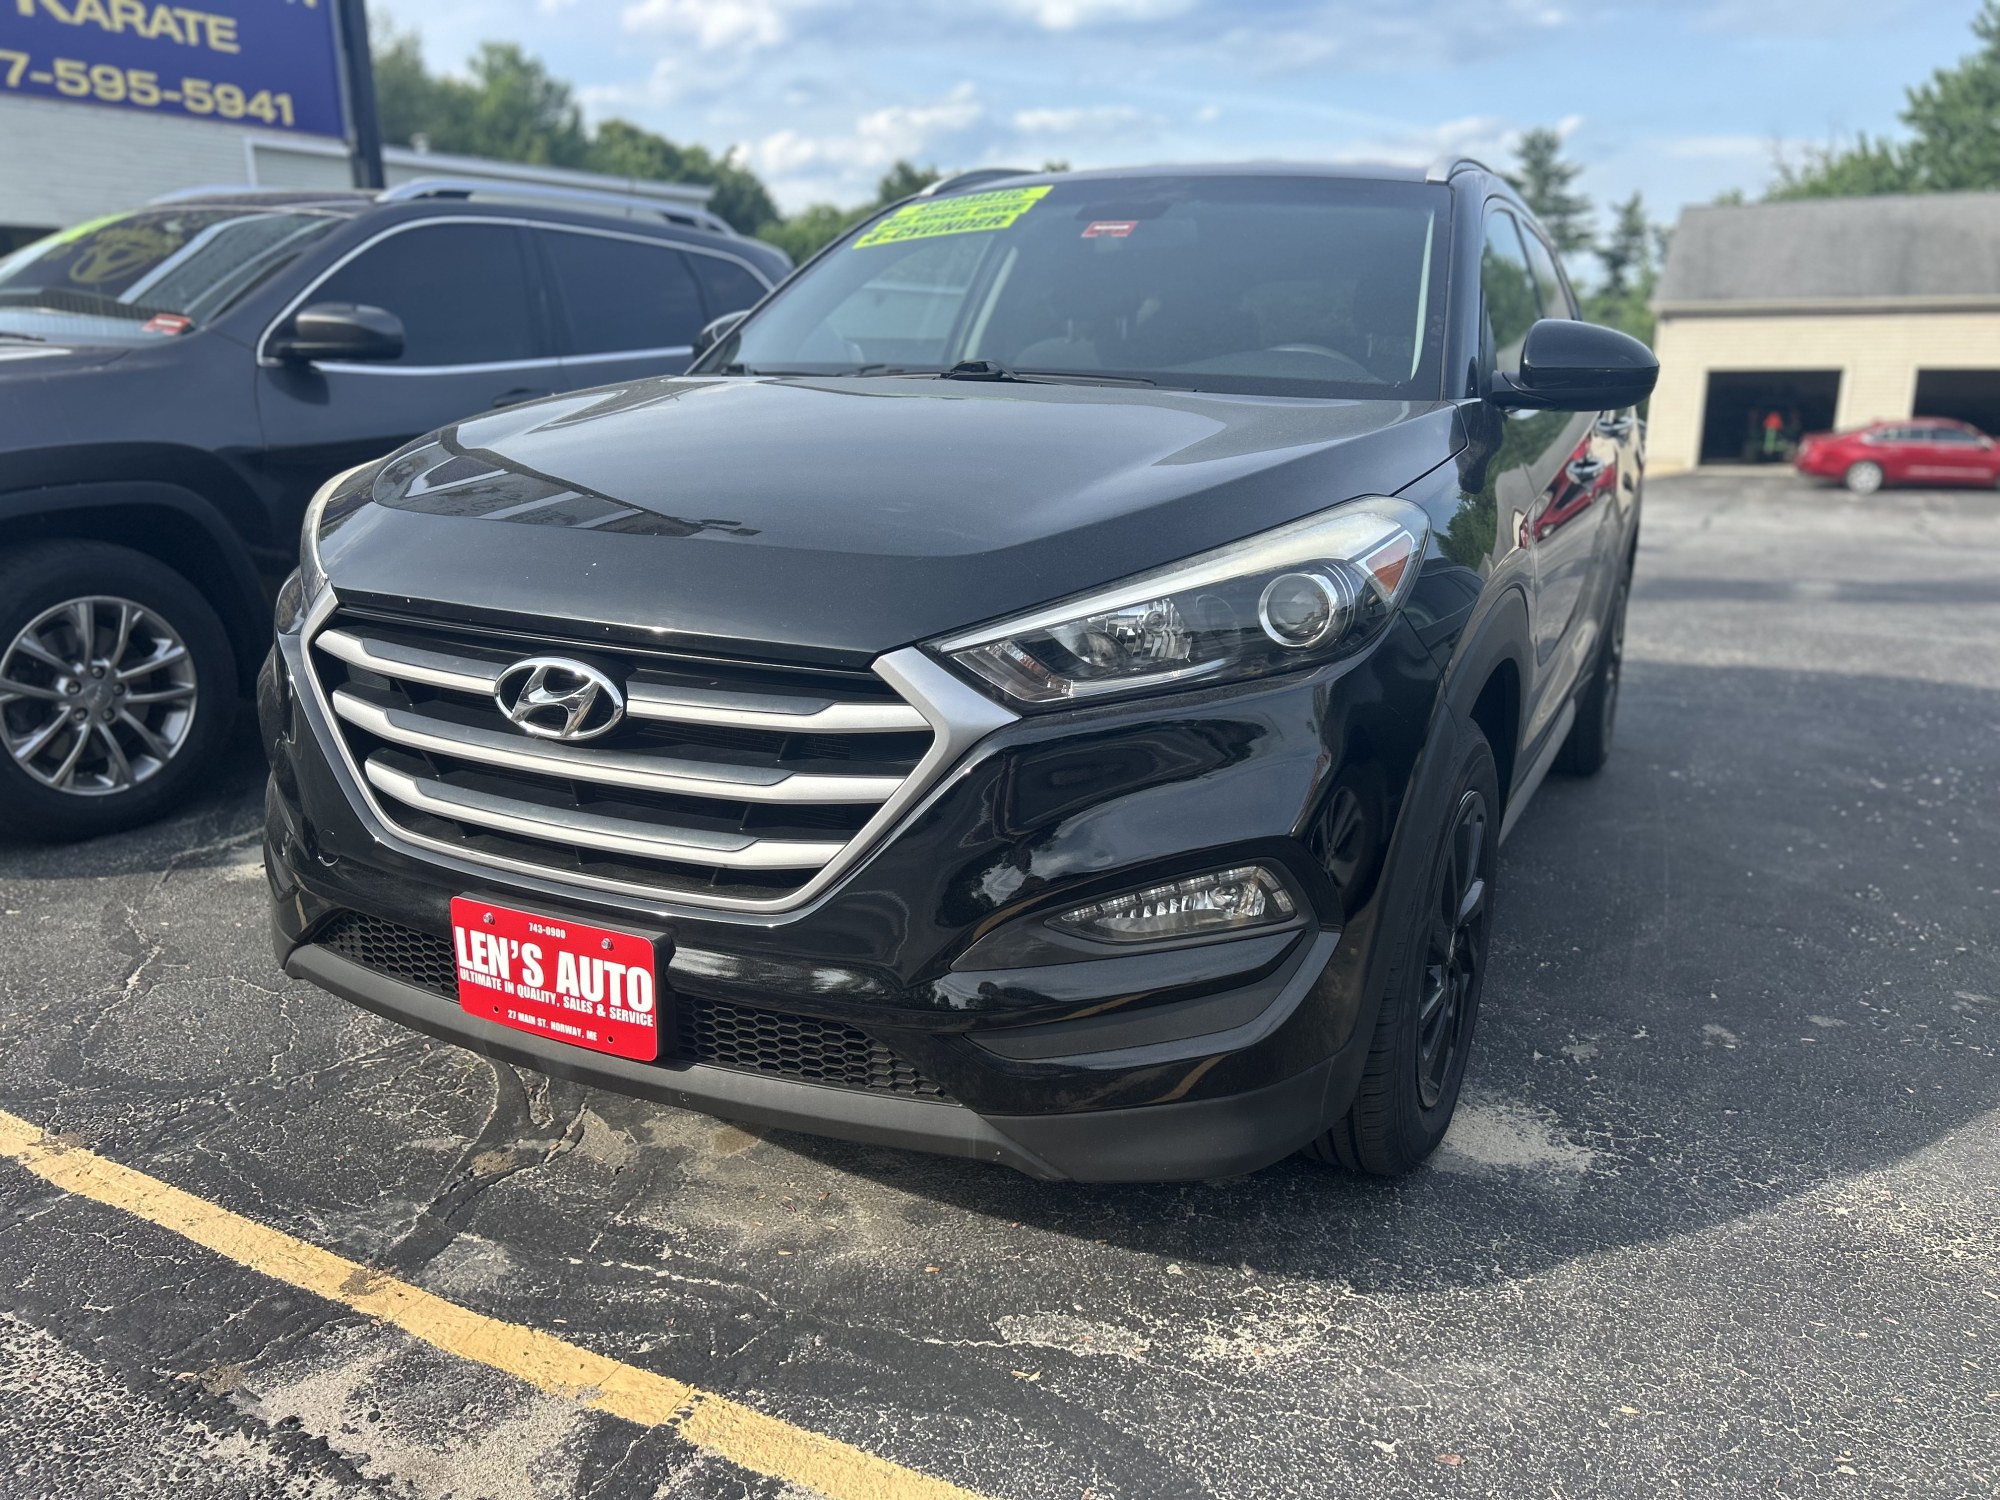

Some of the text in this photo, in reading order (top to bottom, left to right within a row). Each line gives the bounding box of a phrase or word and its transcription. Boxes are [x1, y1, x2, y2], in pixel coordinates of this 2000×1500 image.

[17, 0, 241, 54] KARATE
[528, 922, 566, 939] 743-0900
[454, 925, 653, 1012] LEN'S AUTO
[460, 967, 654, 1028] ULTIMATE IN QUALITY, SALES & SERVICE
[507, 1009, 517, 1020] 27
[518, 1012, 536, 1026] MAIN
[586, 1030, 598, 1042] ME
